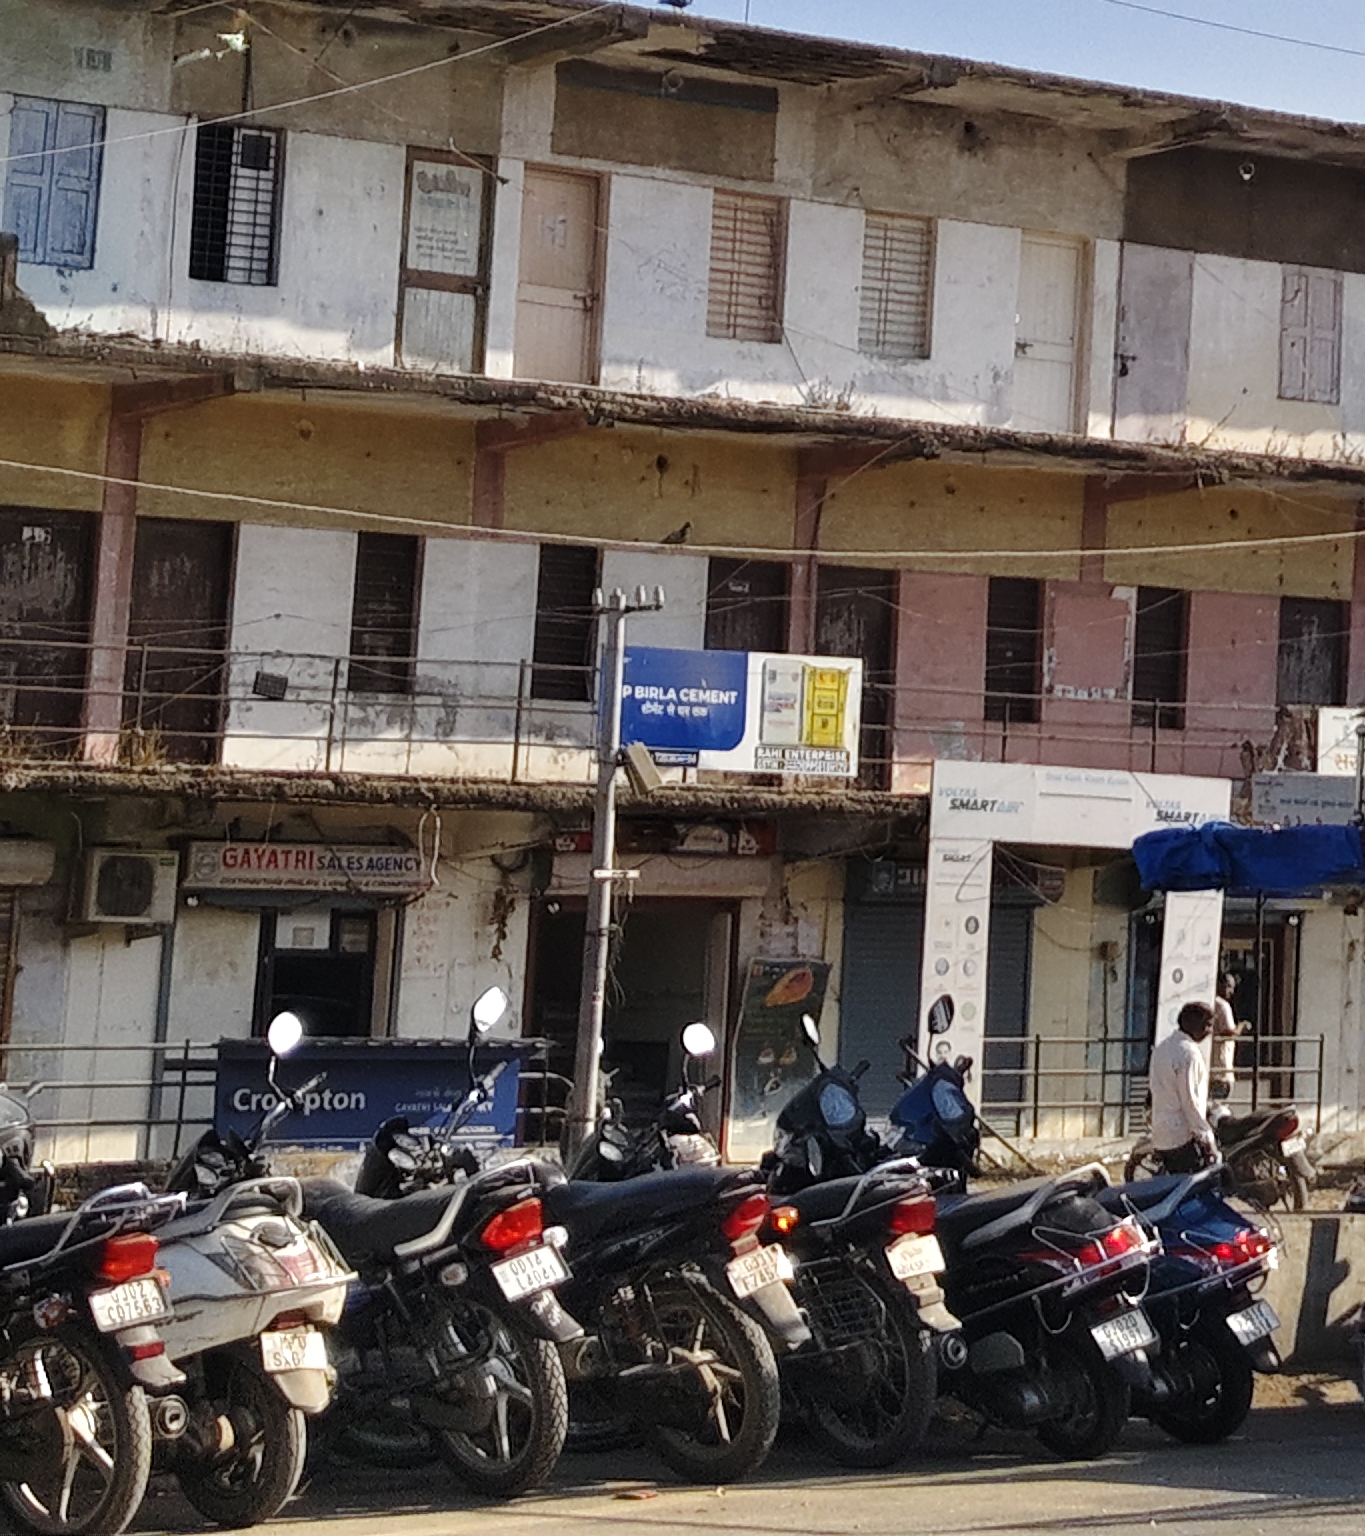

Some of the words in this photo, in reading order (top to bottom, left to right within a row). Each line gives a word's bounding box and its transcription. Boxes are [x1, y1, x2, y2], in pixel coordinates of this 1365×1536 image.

[635, 686, 678, 703] BIRLA
[679, 688, 739, 706] CEMENT
[757, 748, 783, 762] RAHI
[222, 846, 315, 871] GAYATRI
[316, 854, 365, 872] SALES
[365, 855, 421, 872] AGENCY
[233, 1087, 366, 1115] Cropton
